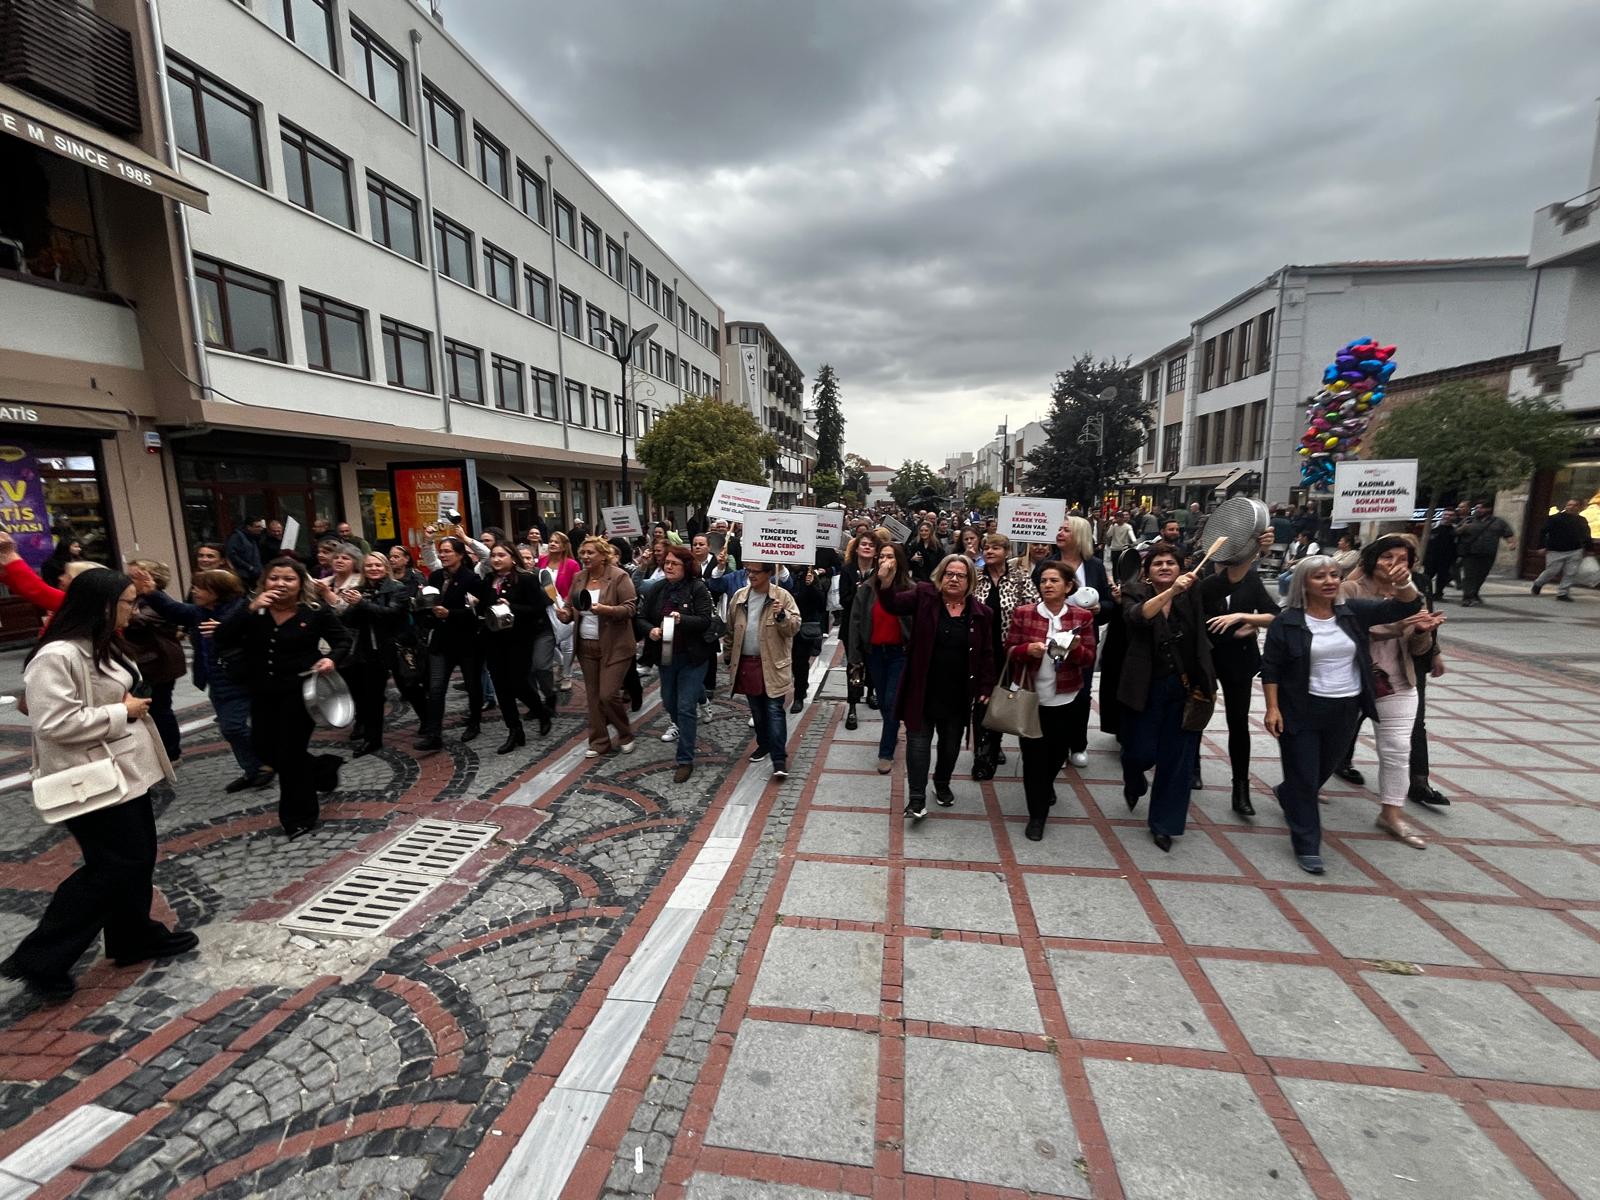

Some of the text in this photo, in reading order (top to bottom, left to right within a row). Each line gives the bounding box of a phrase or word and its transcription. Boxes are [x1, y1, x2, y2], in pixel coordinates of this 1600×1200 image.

[54, 135, 110, 169] SINCE
[117, 163, 153, 186] 1985
[1357, 480, 1395, 488] KADINLAR
[1341, 489, 1386, 497] MUTFAKTAN
[761, 527, 798, 536] TENCEREDE
[782, 535, 798, 543] YOK,
[752, 542, 805, 550] HALKIN CEBİNDE
[779, 549, 795, 557] YOK!
